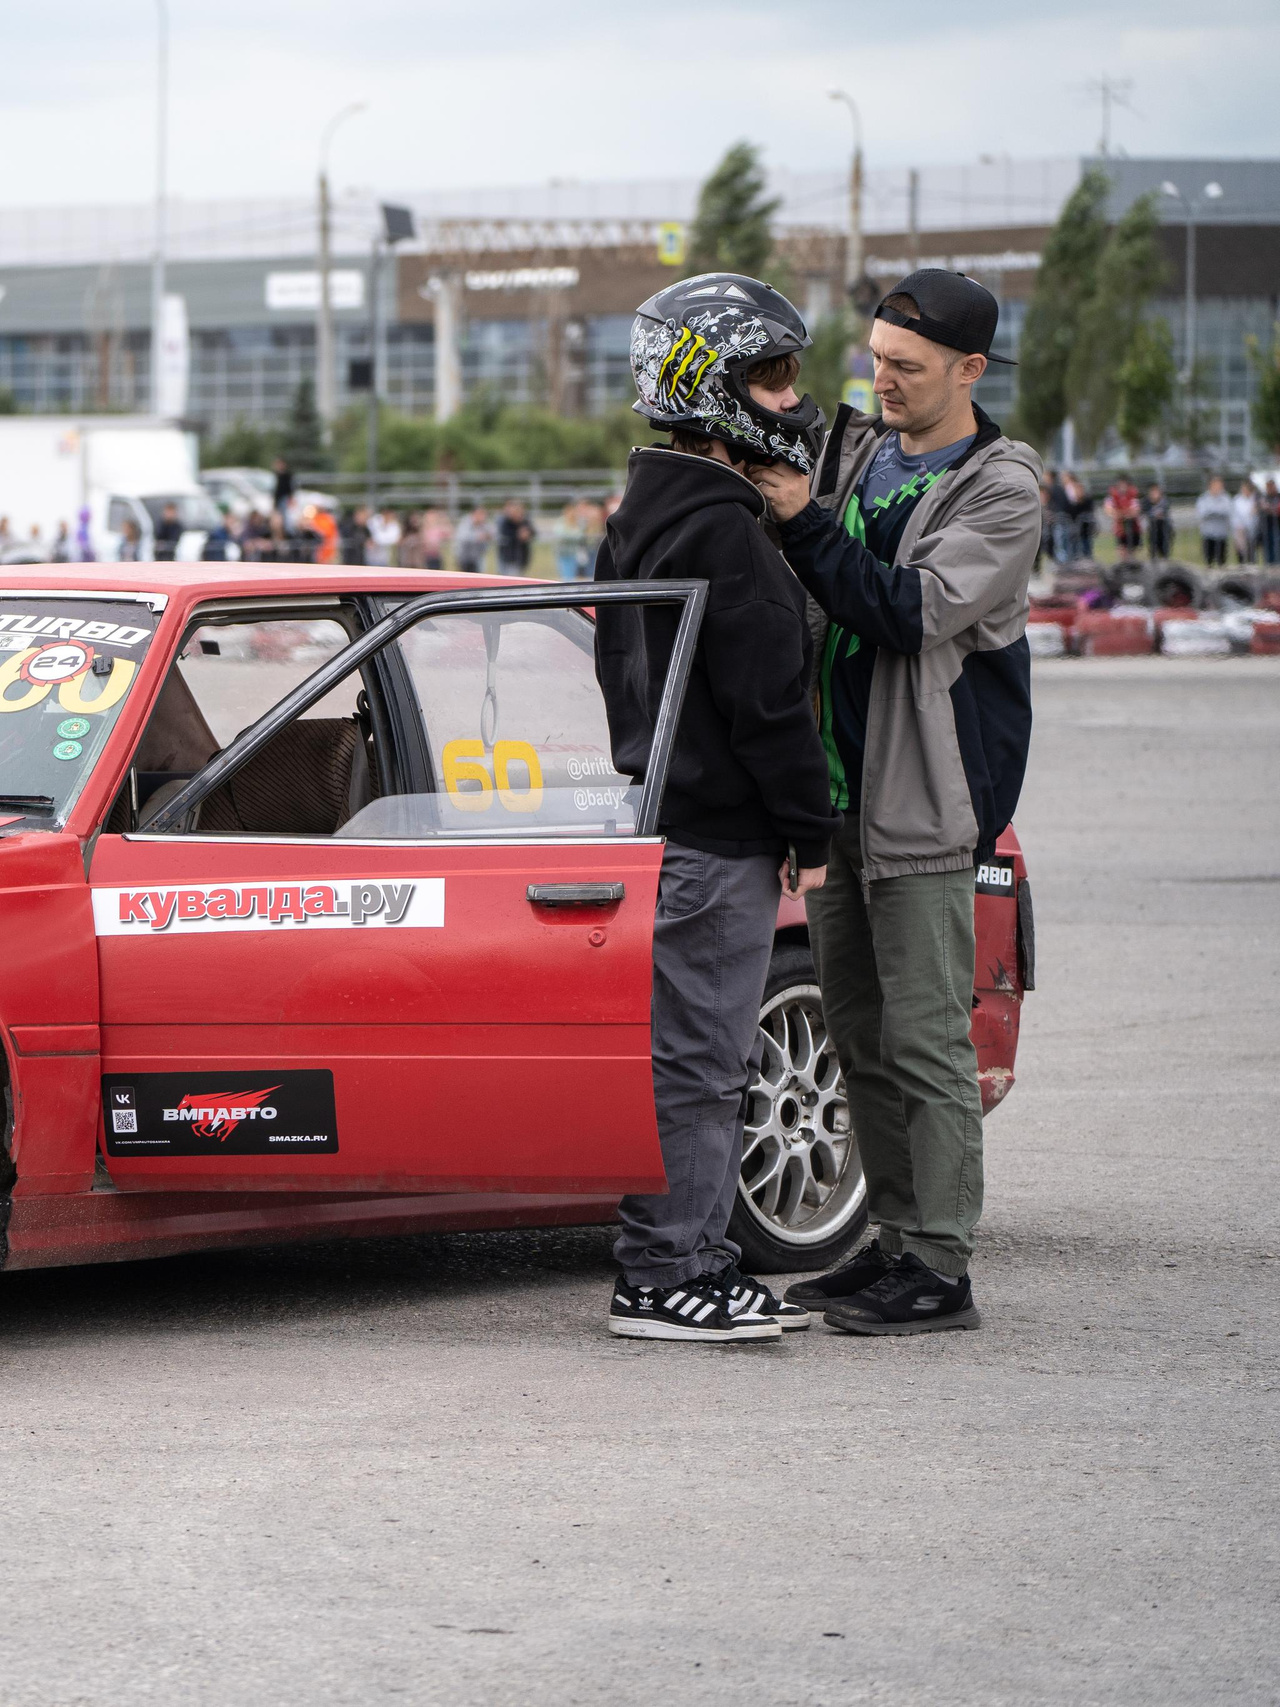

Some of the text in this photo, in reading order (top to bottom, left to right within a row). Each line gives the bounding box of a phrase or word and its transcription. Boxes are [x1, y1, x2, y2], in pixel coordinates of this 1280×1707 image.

[32, 655, 81, 669] 24
[442, 739, 543, 813] 60
[975, 865, 1012, 886] RBO
[118, 883, 416, 930] кувалда.ру
[162, 1106, 278, 1121] ВМПАВТО
[268, 1135, 328, 1143] SMAZKA.RU
